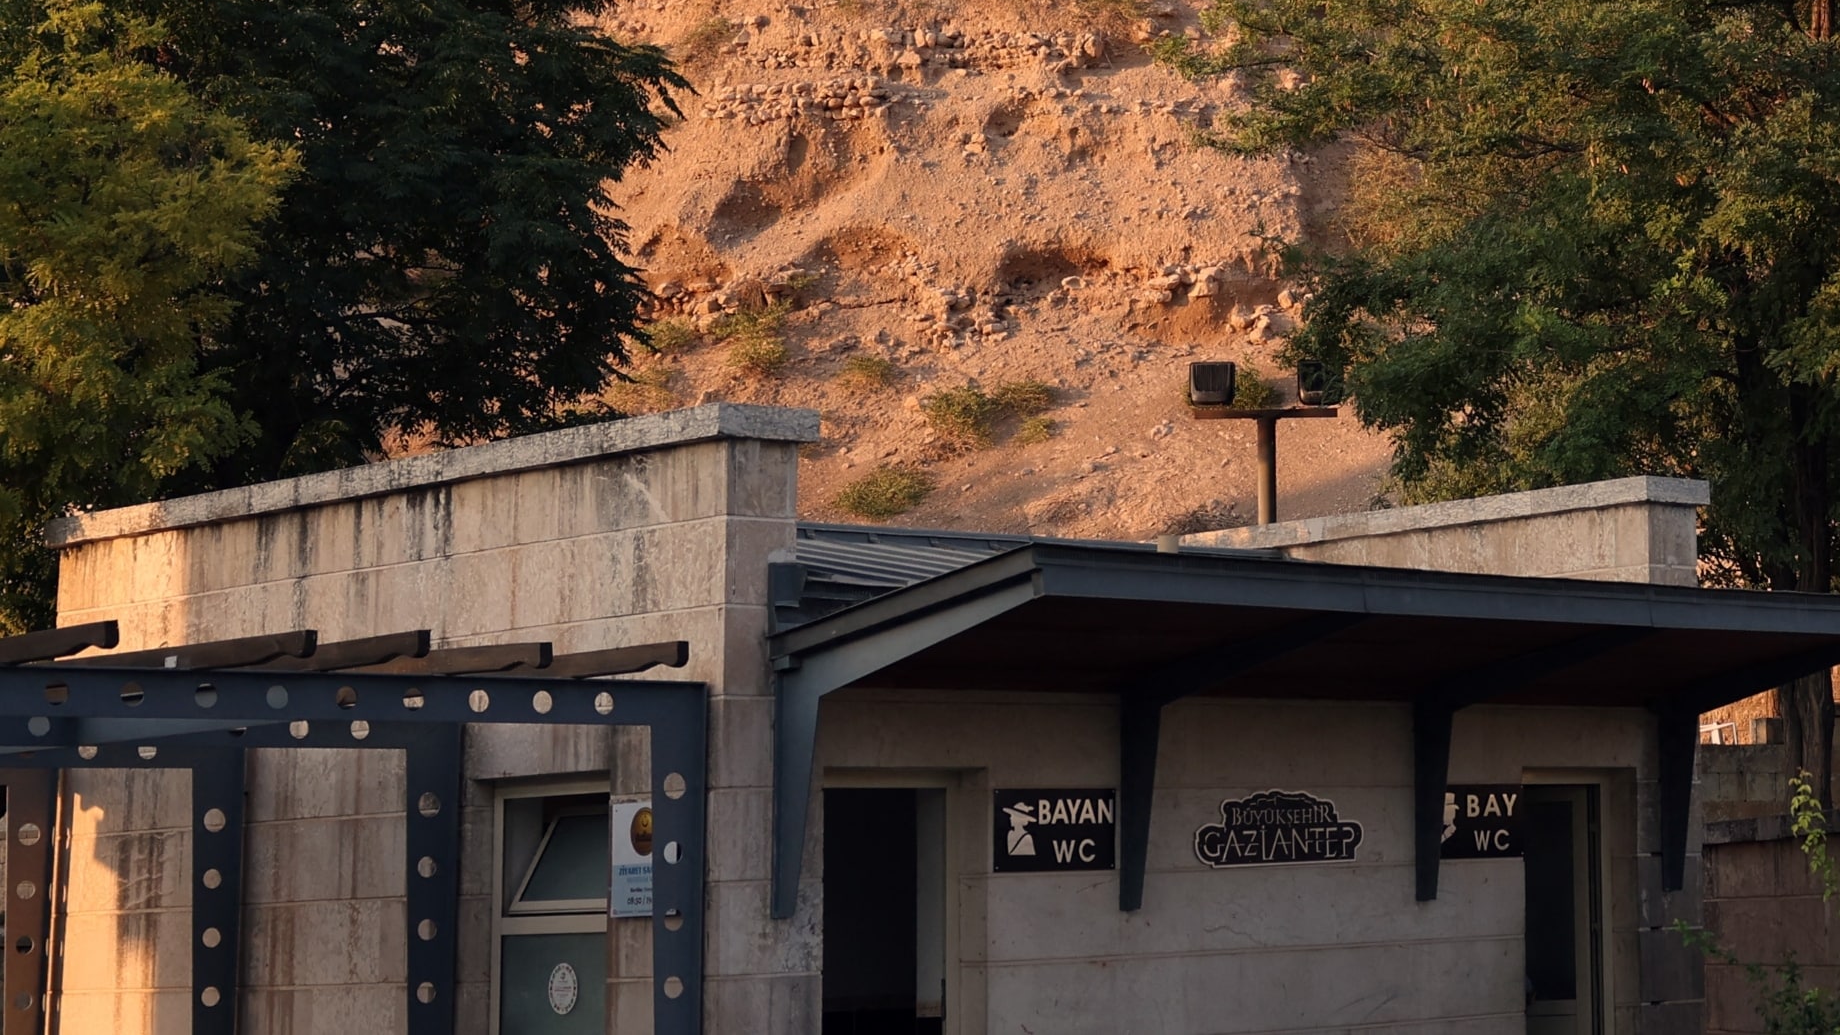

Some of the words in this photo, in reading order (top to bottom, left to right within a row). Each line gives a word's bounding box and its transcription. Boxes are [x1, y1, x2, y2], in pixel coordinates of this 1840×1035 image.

[1038, 798, 1114, 825] BAYAN
[1467, 793, 1517, 818] BAY
[1052, 838, 1096, 863] WC
[1203, 825, 1355, 863] GAZİANTEP
[1474, 829, 1510, 851] WC
